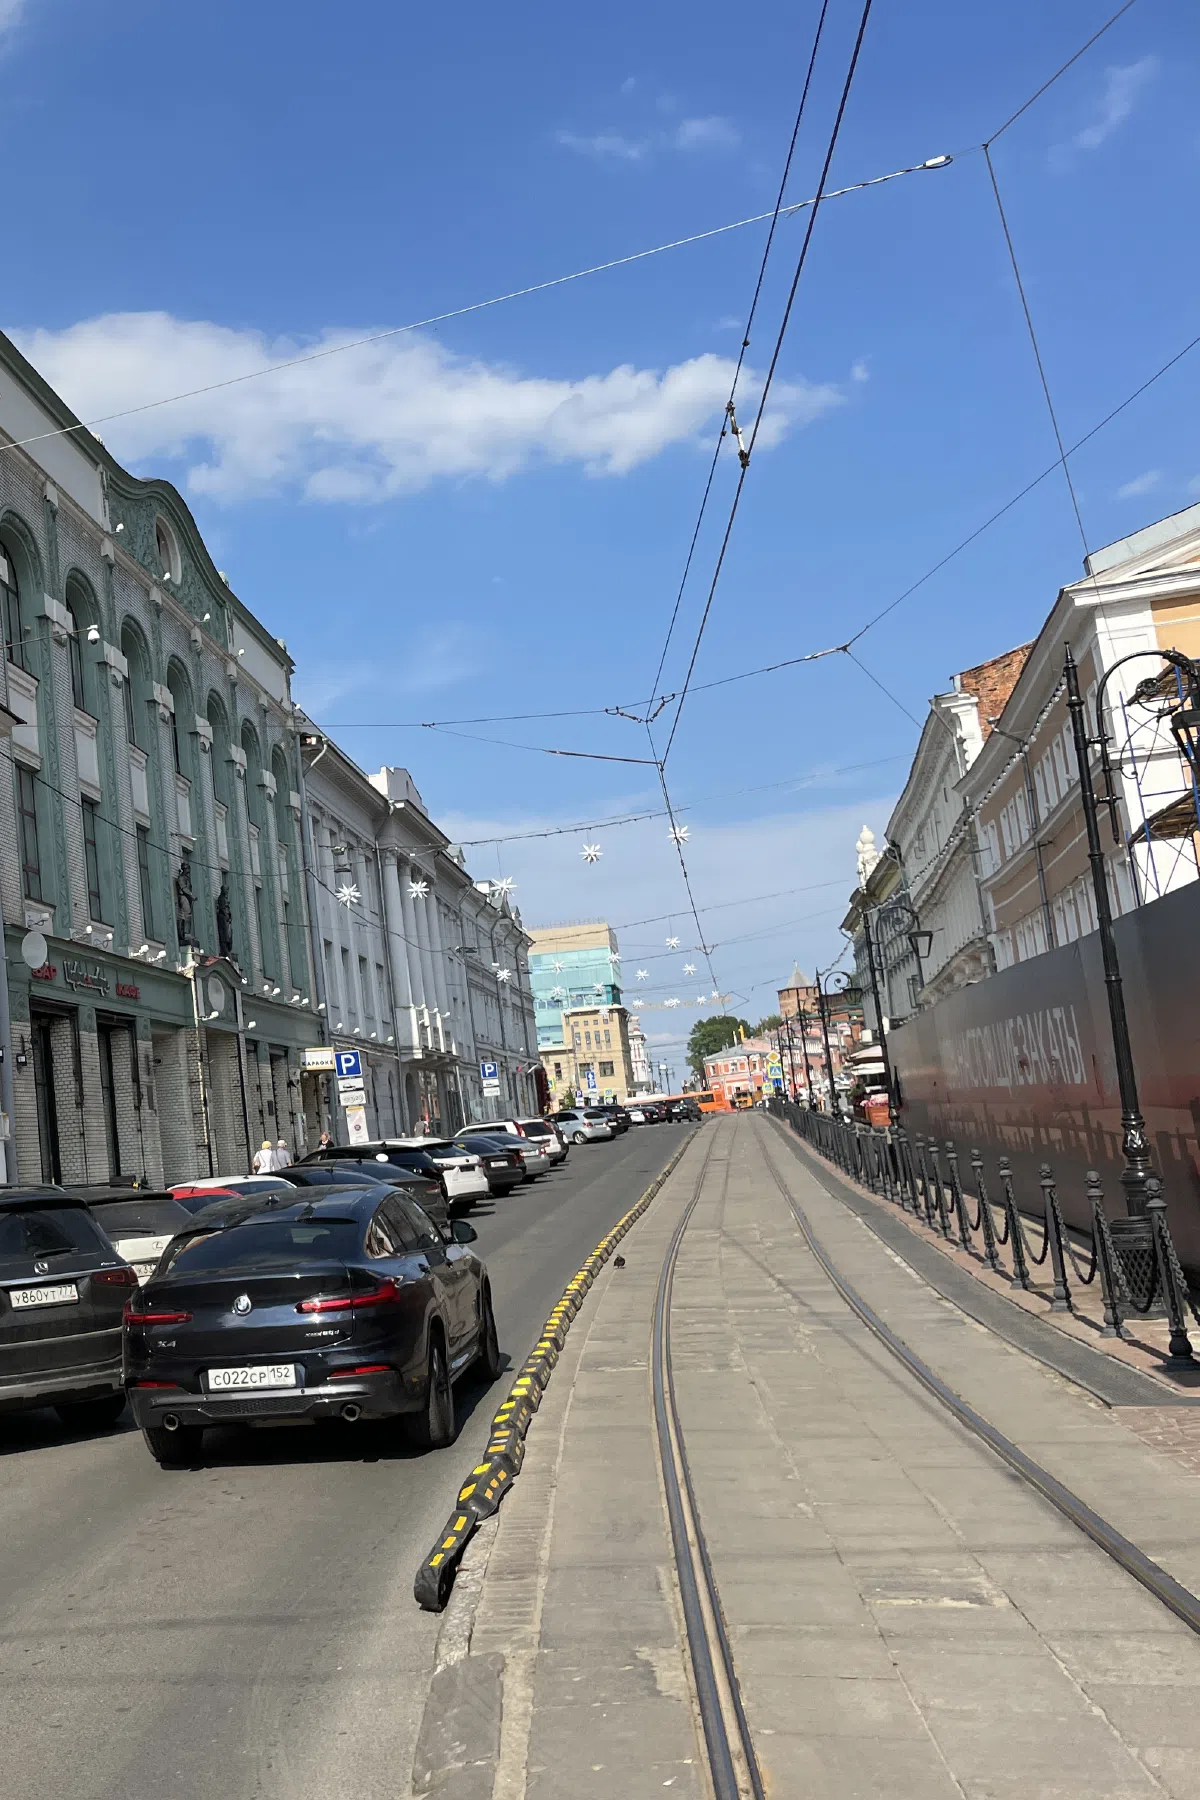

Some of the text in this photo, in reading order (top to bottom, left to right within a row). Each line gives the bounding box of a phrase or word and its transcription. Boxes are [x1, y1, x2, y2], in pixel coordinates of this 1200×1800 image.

[1017, 1005, 1088, 1085] ЗАКАТЫ
[341, 1054, 355, 1074] P
[214, 1367, 290, 1386] С022СР 152
